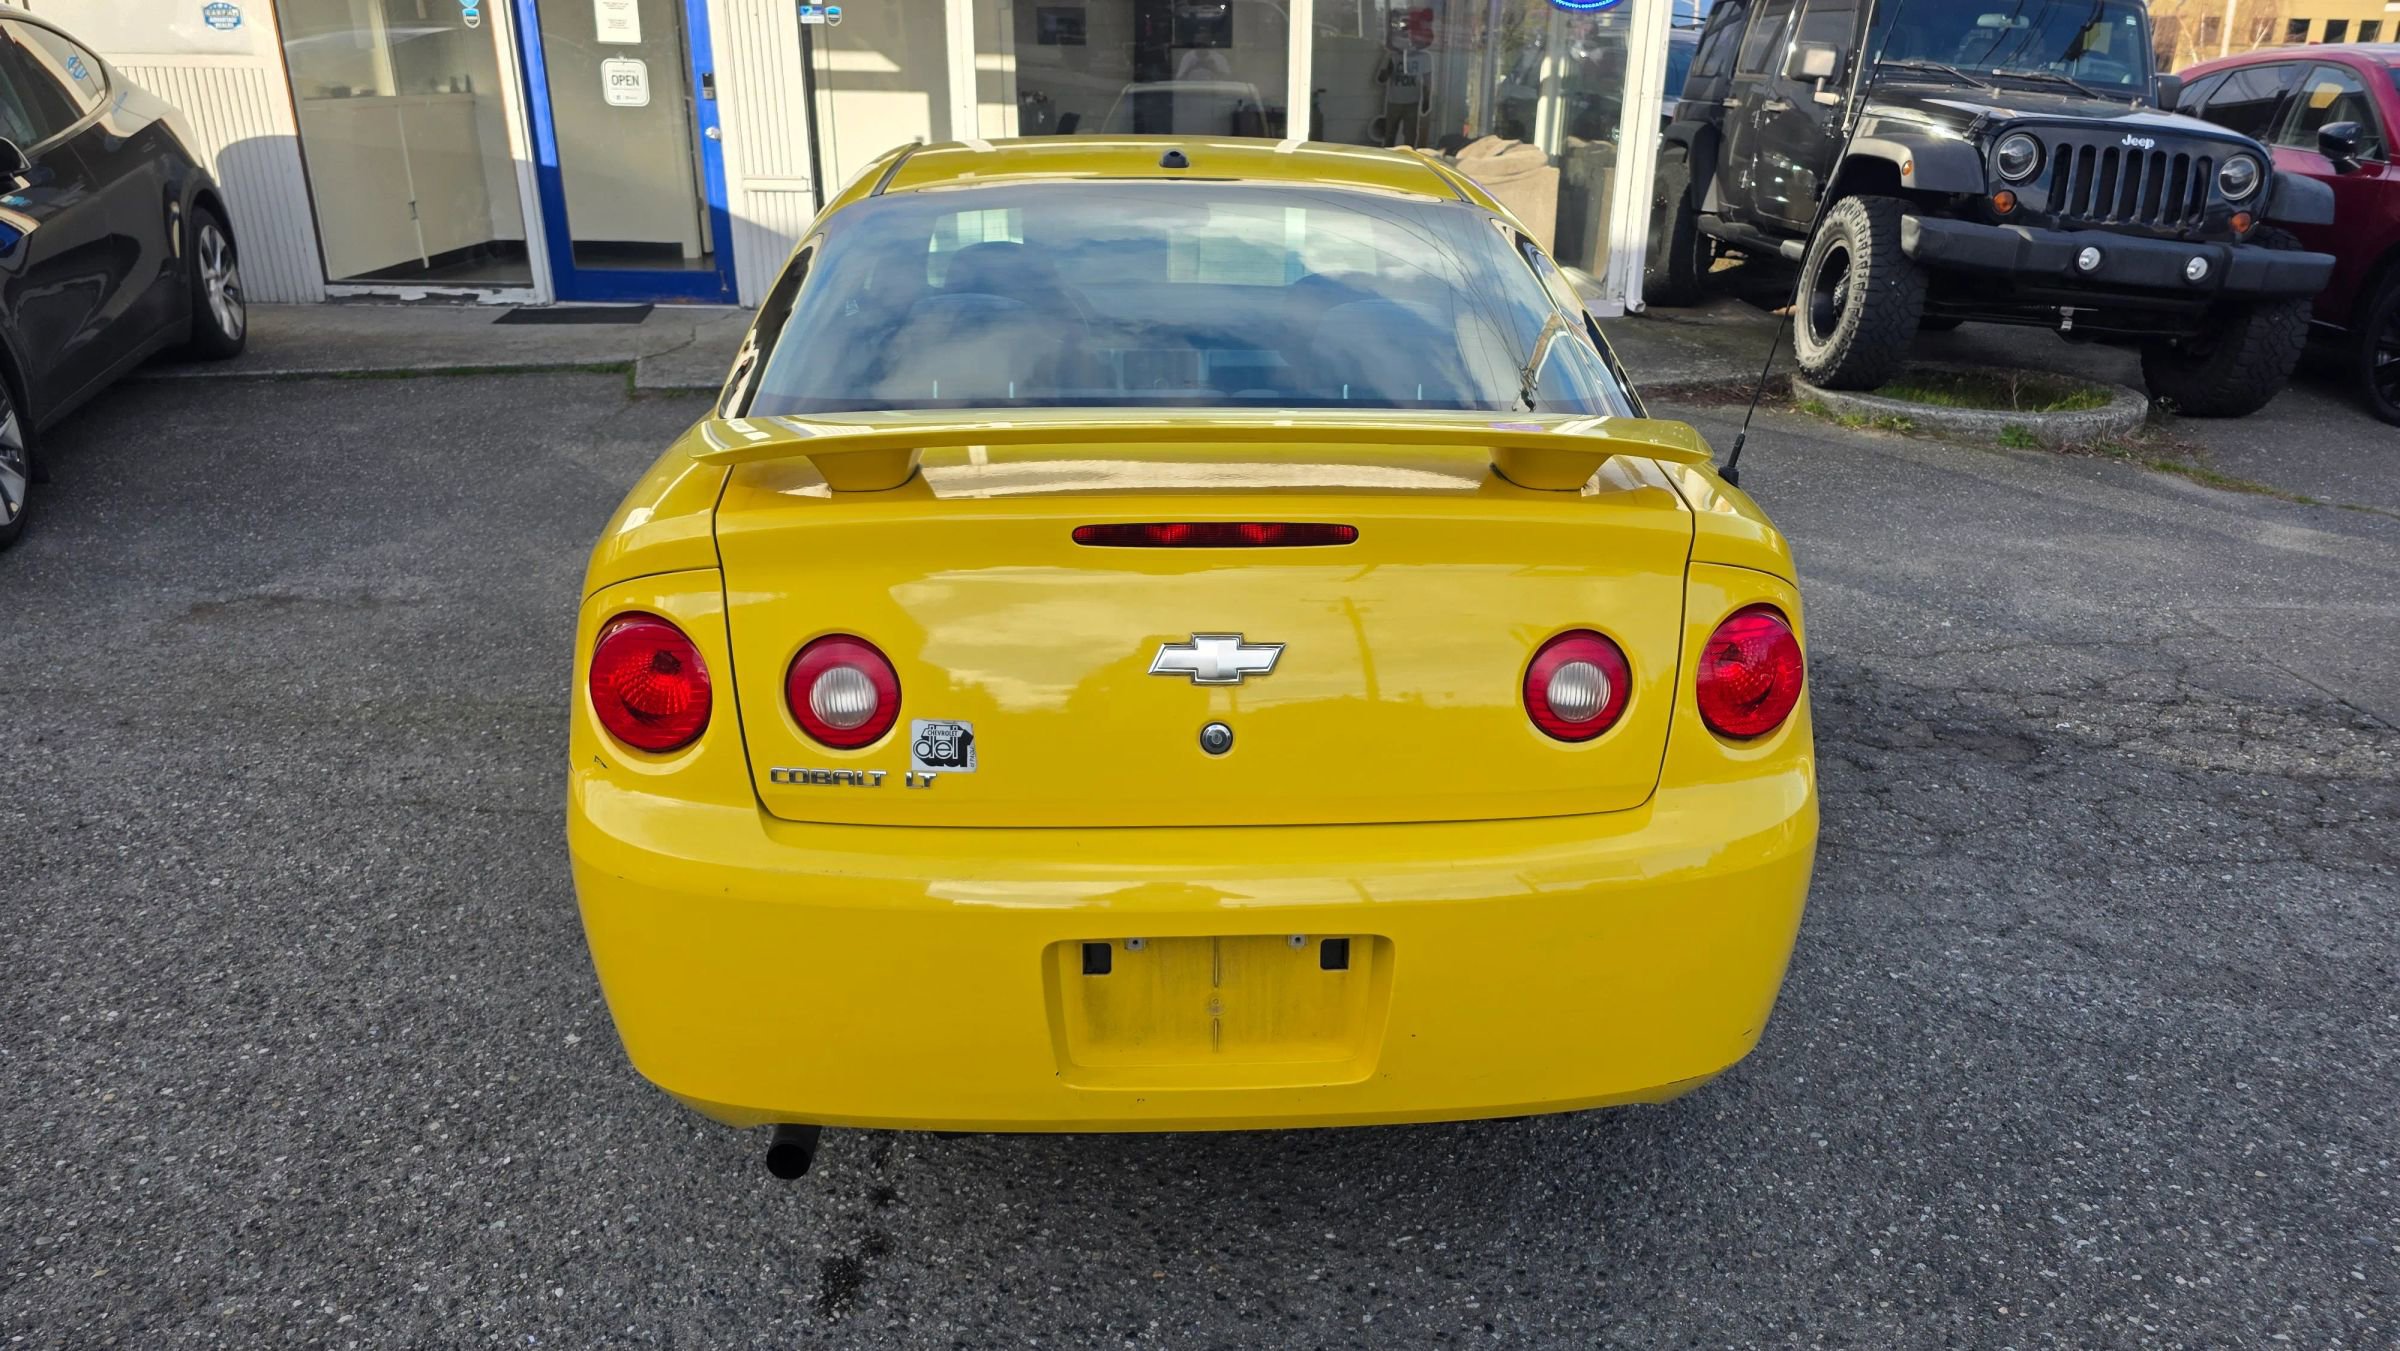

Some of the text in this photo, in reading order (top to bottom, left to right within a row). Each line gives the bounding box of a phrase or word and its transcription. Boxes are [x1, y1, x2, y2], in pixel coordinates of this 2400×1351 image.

[611, 74, 640, 86] OPEN
[2121, 133, 2156, 150] Jeep
[927, 729, 959, 737] CHEVROLET
[770, 767, 937, 789] COBALT LT
